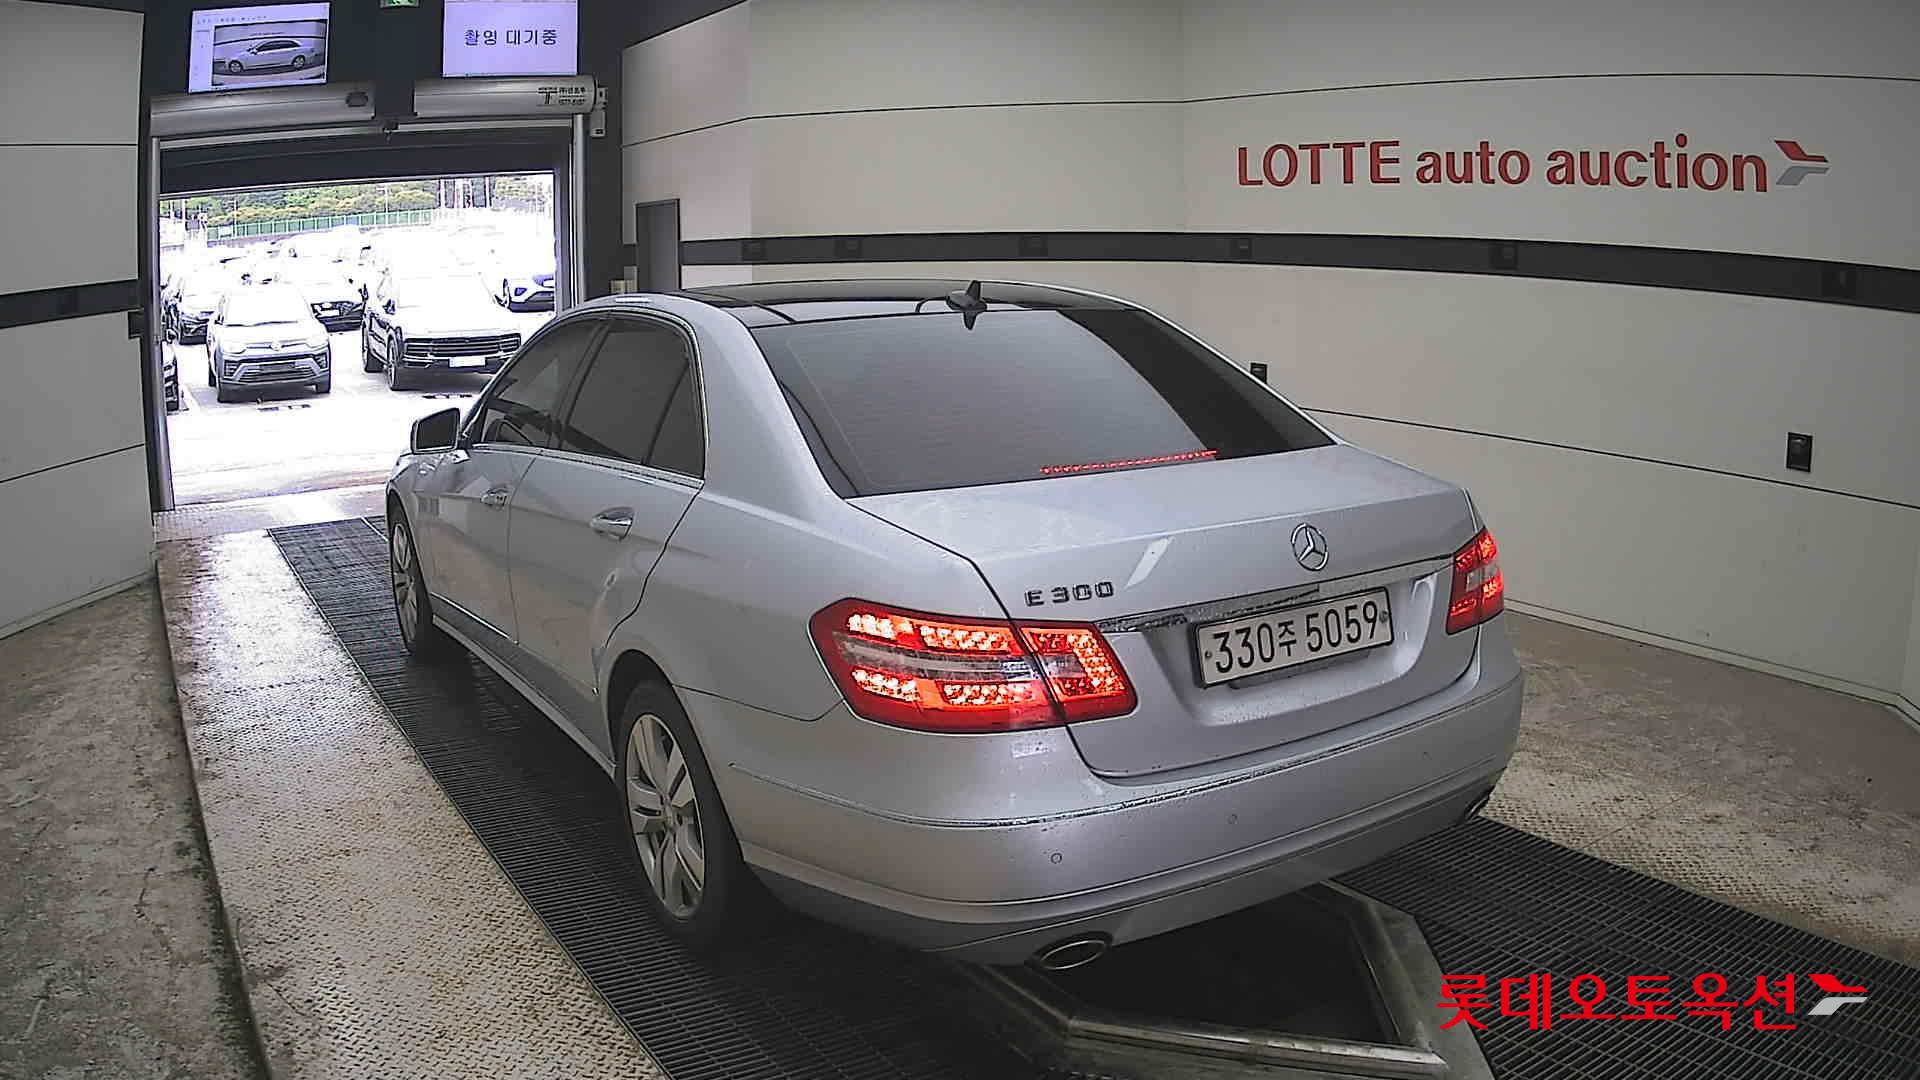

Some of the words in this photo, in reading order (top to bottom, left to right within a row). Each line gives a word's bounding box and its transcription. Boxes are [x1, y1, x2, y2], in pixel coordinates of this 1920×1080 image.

[464, 29, 497, 46] 촬영
[505, 29, 558, 46] 대기중
[1236, 140, 1400, 187] LOTTE
[1415, 140, 1531, 185] auto
[1545, 133, 1768, 193] auction
[1024, 589, 1045, 607] E
[1051, 581, 1114, 603] 300
[1305, 600, 1378, 653] 5059
